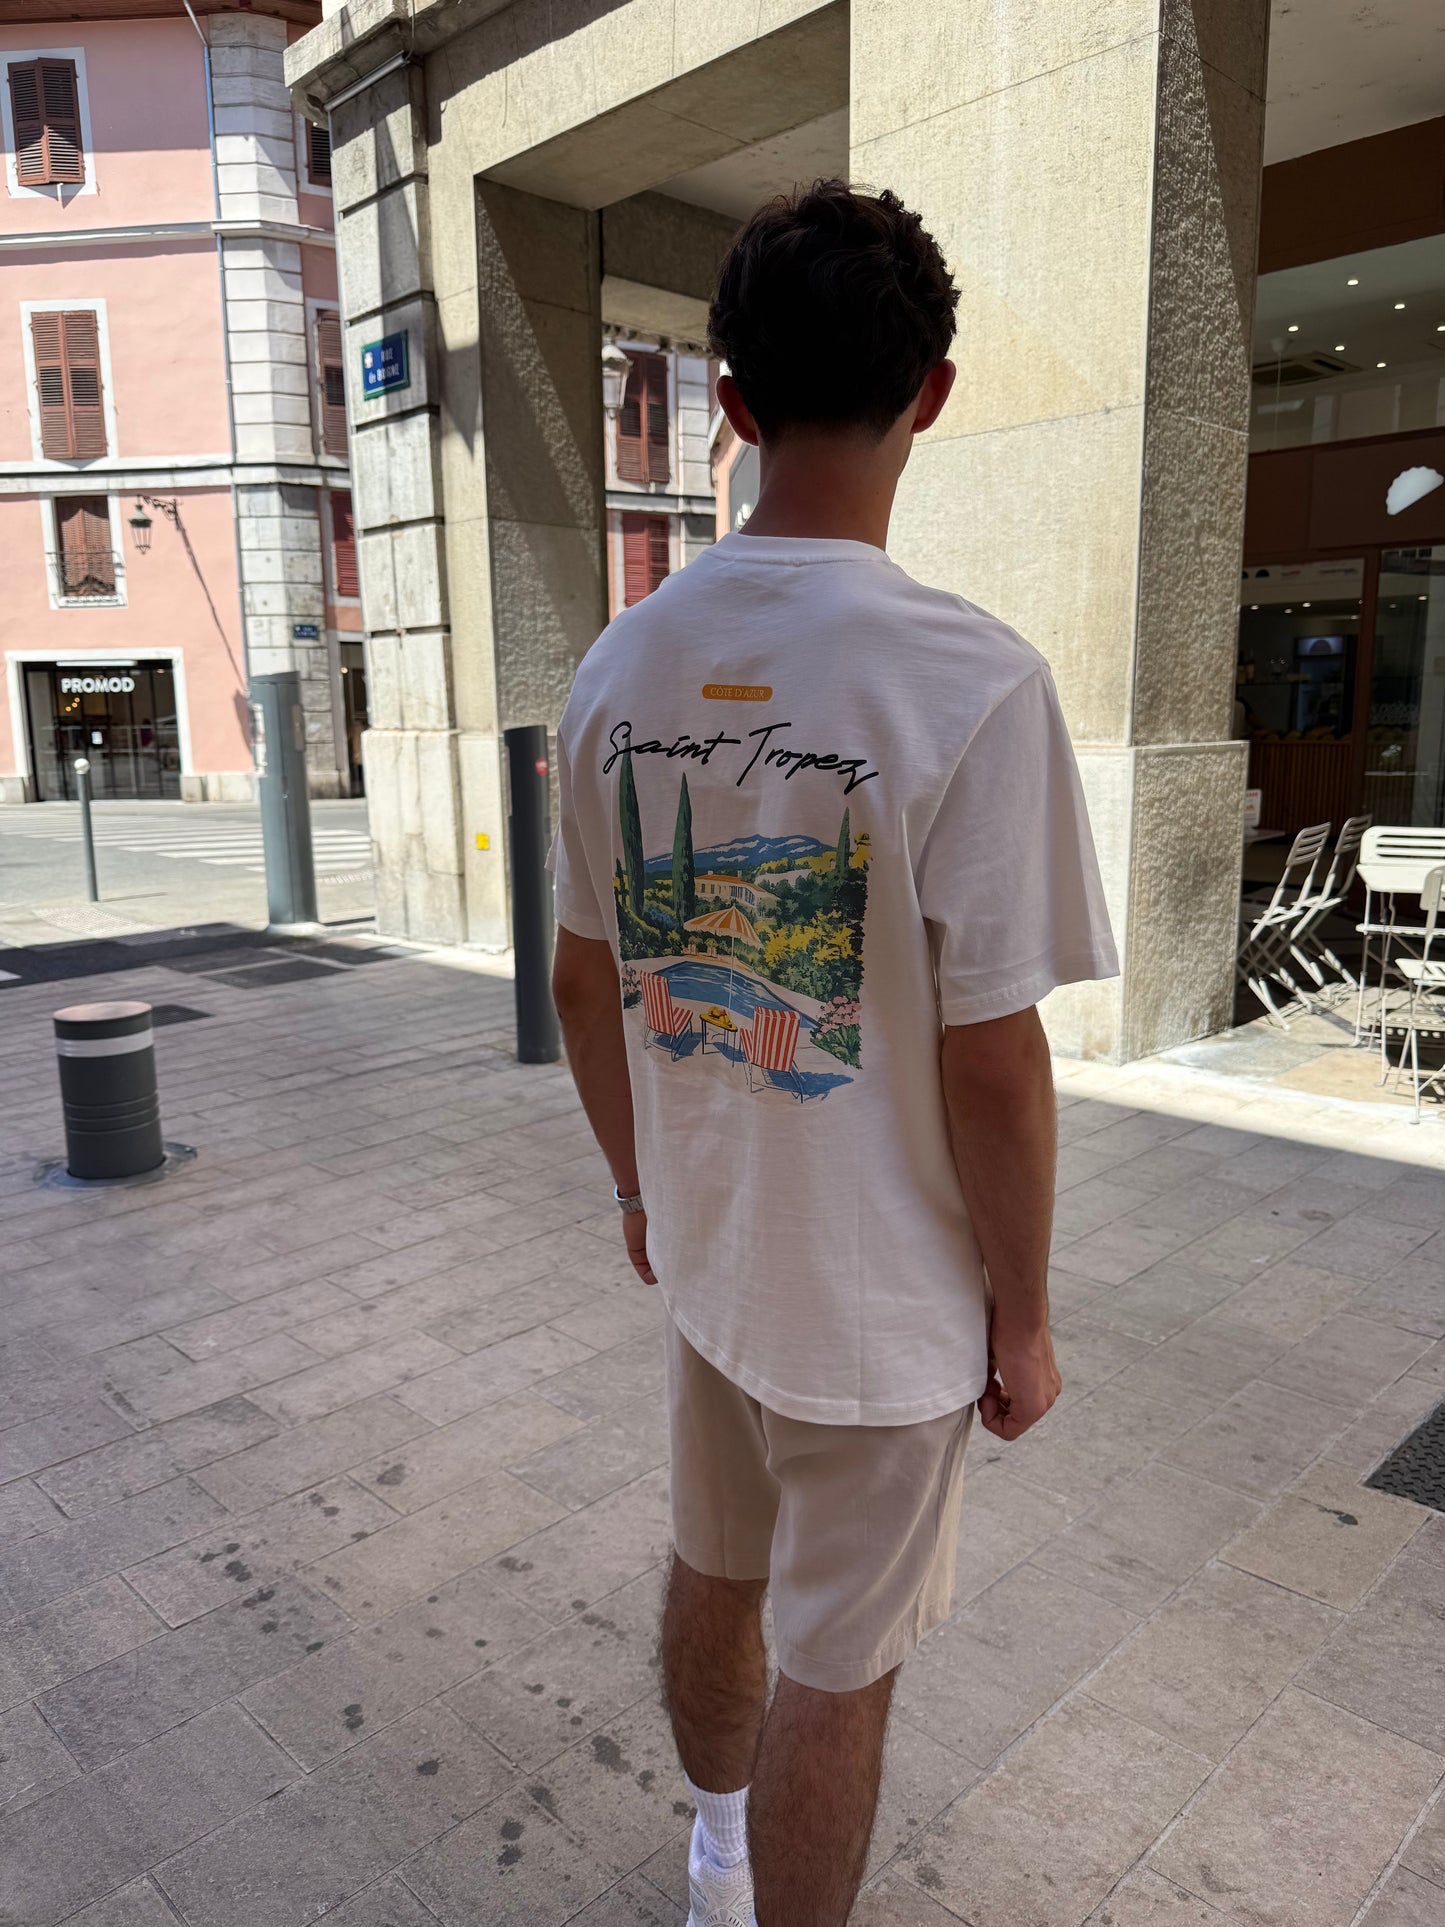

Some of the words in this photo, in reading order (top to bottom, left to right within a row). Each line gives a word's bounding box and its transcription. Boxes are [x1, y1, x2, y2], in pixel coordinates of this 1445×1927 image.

[61, 677, 135, 693] PROMOD
[734, 687, 765, 698] D'AZUR
[602, 720, 741, 774] Saint
[736, 721, 879, 795] Tropez
